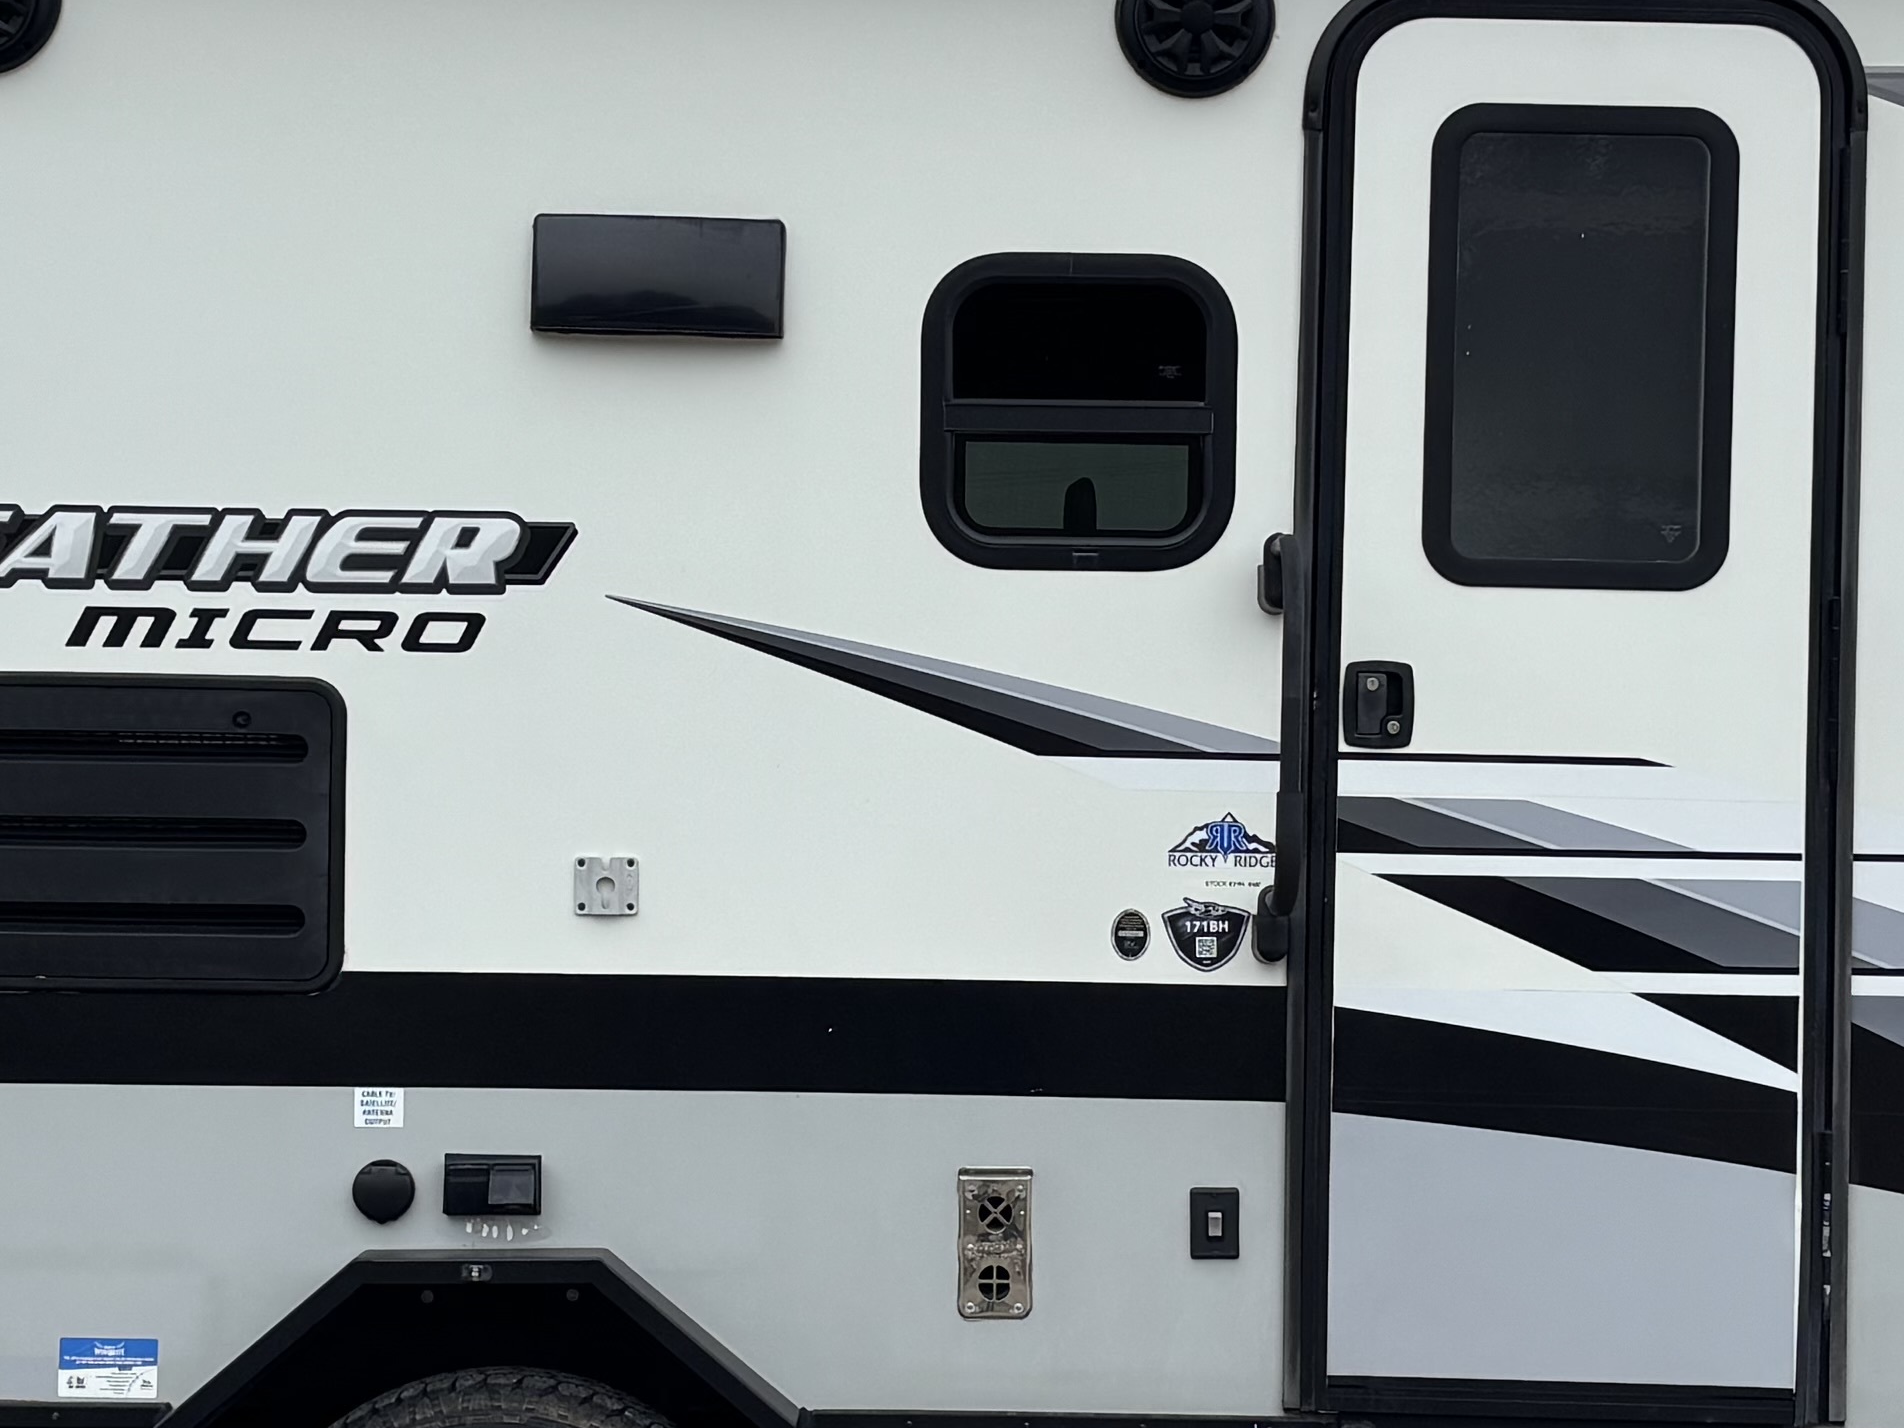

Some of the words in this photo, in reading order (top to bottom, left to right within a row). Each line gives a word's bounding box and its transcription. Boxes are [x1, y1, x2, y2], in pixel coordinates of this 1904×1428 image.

[65, 606, 487, 654] MICRO
[1168, 854, 1218, 867] ROCKY
[1234, 855, 1276, 868] RIDGE
[1185, 921, 1229, 933] 171BH
